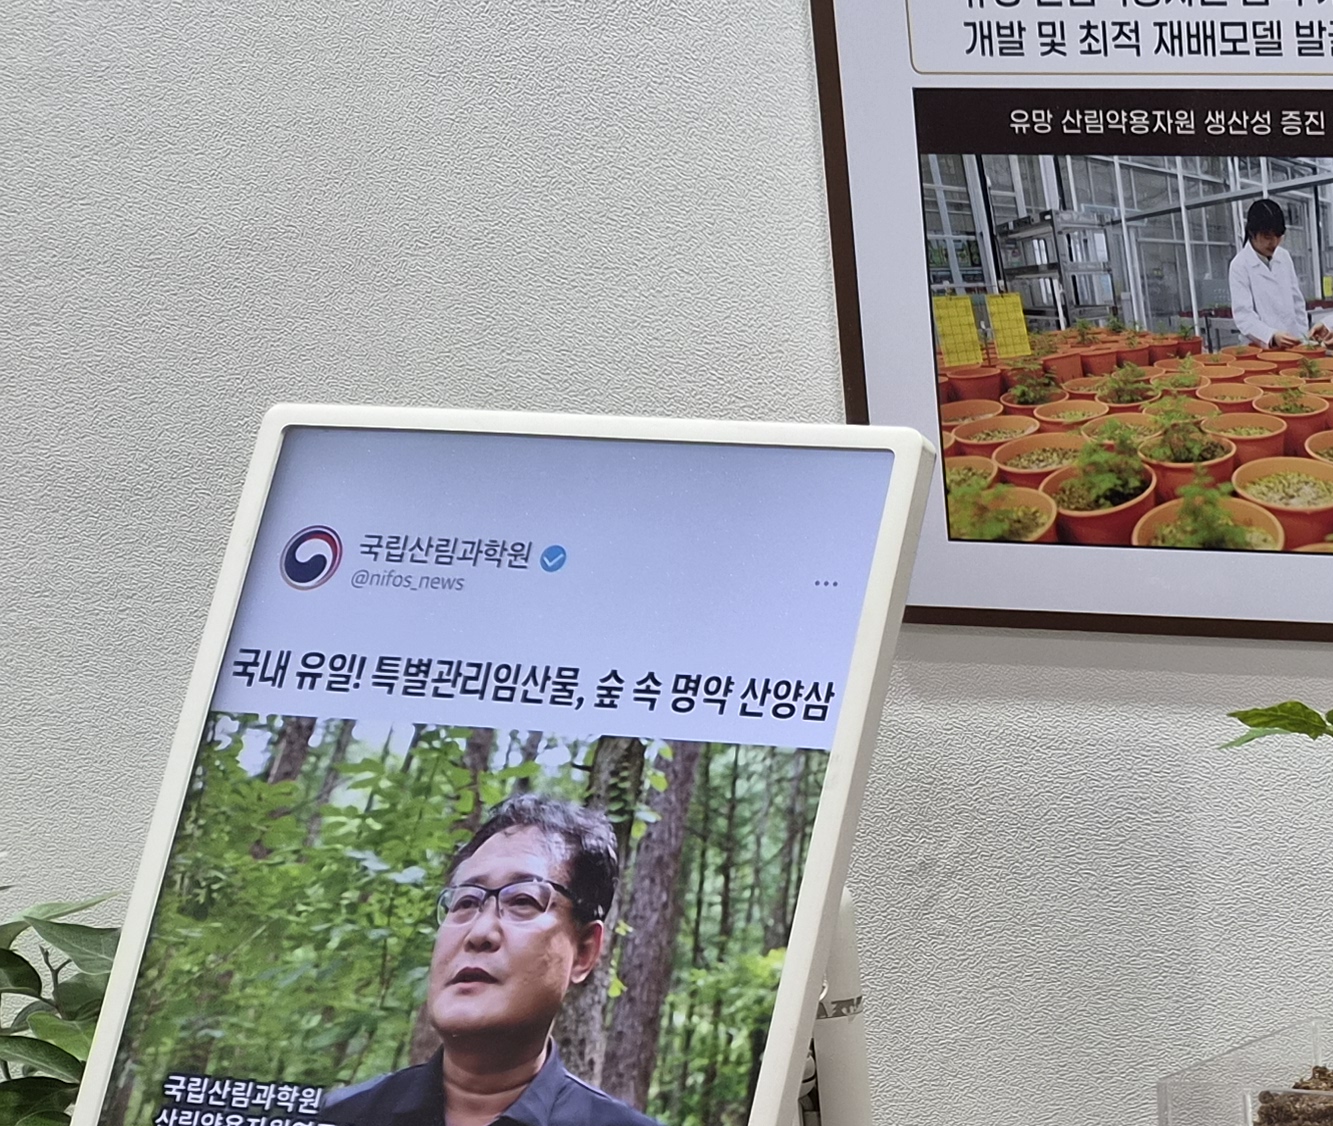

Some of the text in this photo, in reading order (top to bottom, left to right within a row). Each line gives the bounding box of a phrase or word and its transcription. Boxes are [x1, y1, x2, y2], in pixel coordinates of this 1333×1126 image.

[963, 19, 1026, 58] 개발
[1037, 19, 1067, 58] 및
[1078, 19, 1141, 58] 최적
[1153, 19, 1283, 58] 재배모델
[1008, 109, 1052, 134] 유망
[1061, 109, 1196, 135] 산림약용자원
[1204, 109, 1272, 136] 생산성
[1280, 110, 1326, 136] 증진
[358, 532, 533, 571] 국립산림과학원
[350, 567, 465, 592] @nifos_news
[231, 648, 836, 723] 국내 유일! 특별관리임산물, 숲 속 명약 산양삼
[163, 1074, 324, 1116] 국립산림과학원
